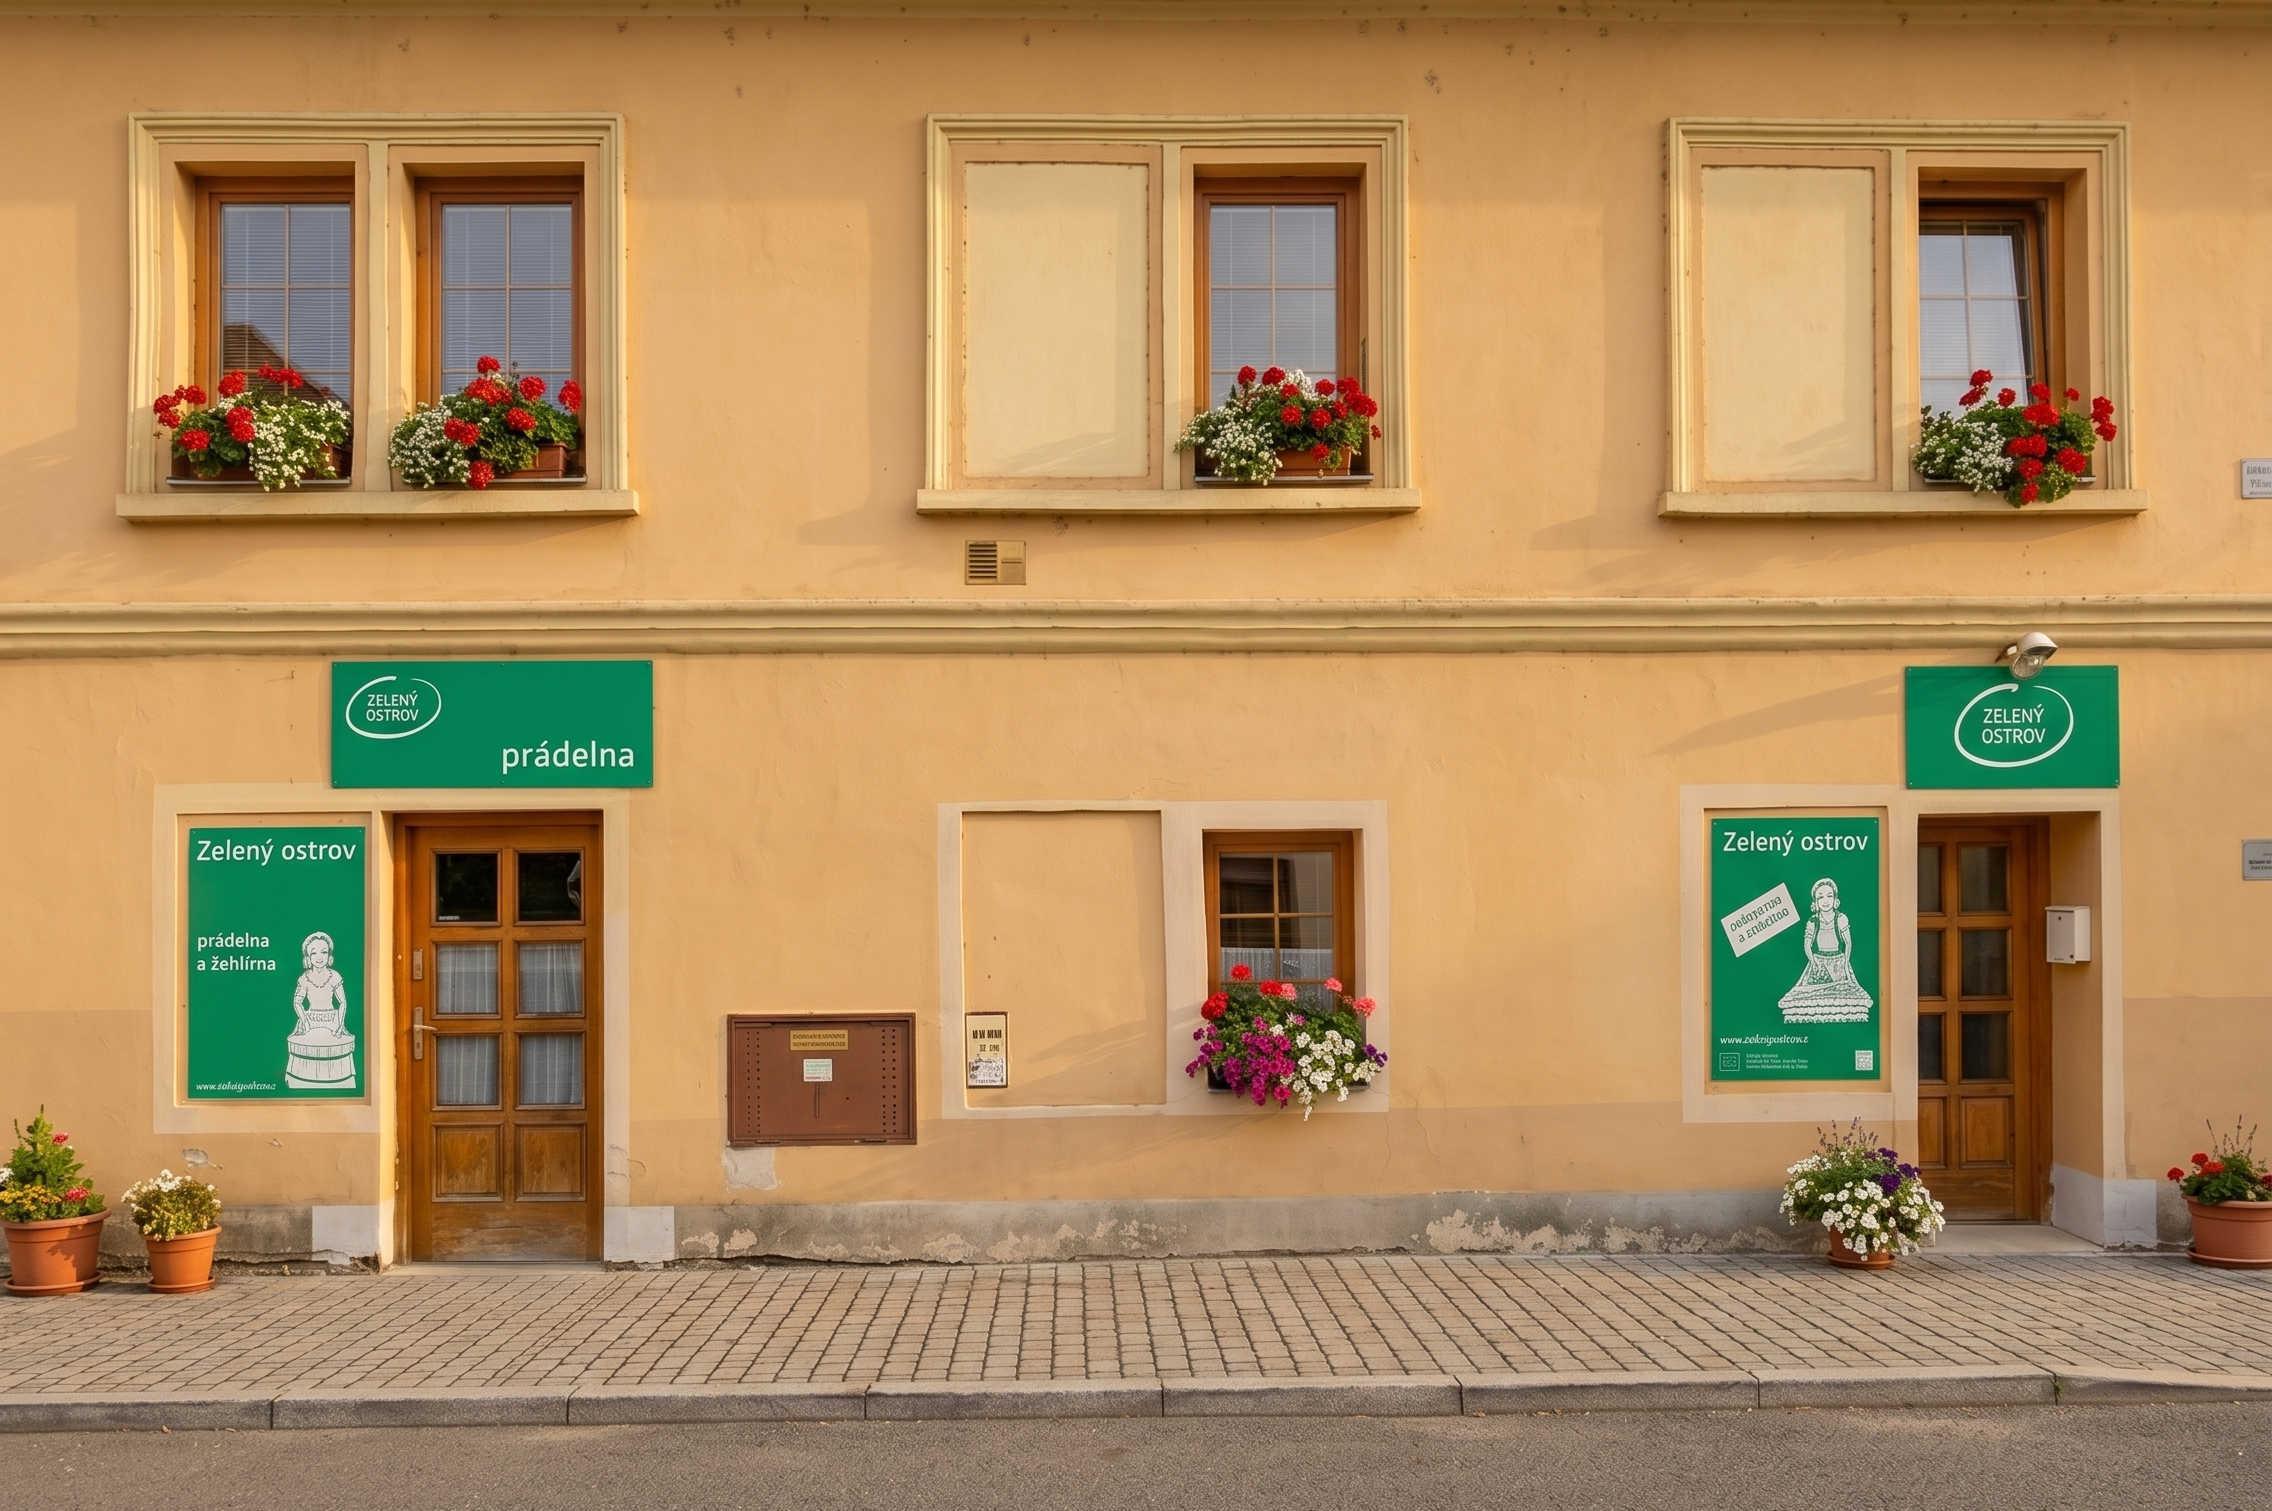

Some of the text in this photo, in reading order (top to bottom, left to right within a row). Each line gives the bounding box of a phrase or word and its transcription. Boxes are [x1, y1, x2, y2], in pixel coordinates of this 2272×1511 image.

[367, 690, 418, 707] ZELENÝ
[366, 708, 419, 722] OSTROV
[1983, 703, 2045, 724] ZELENÝ
[1981, 728, 2046, 745] OSTROV
[502, 740, 634, 775] prádelna
[196, 838, 357, 866] Zelený ostrov
[1723, 830, 1868, 857] Zelený ostrov
[197, 932, 270, 952] prádelna
[196, 955, 276, 971] a žehlírna
